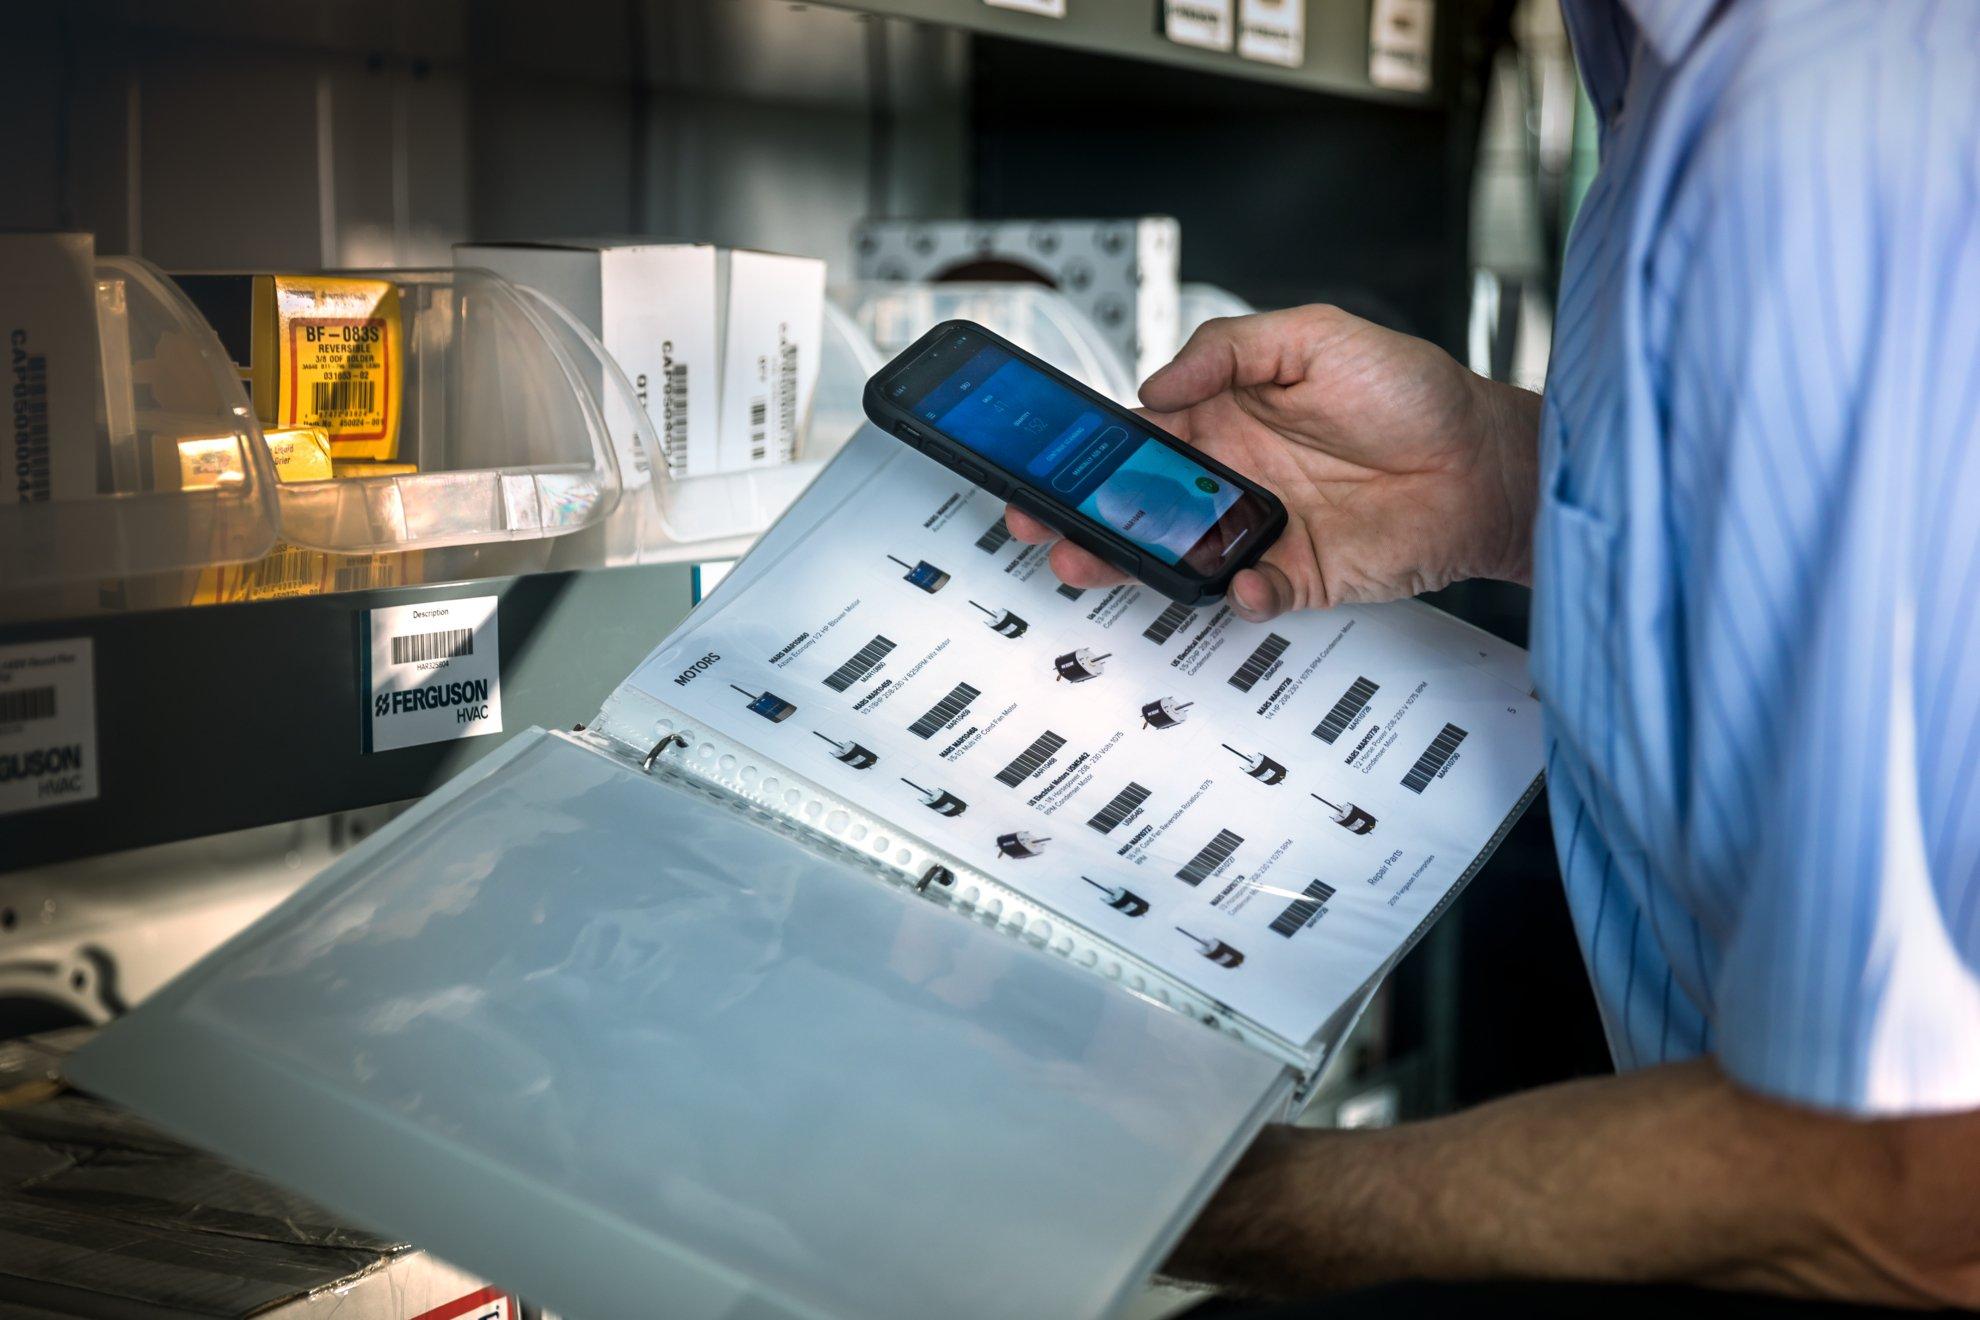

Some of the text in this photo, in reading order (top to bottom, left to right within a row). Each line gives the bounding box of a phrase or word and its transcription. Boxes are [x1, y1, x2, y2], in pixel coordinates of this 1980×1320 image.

[319, 344, 370, 353] REVERSIBLE
[413, 608, 449, 618] Description
[789, 637, 817, 658] Economy
[843, 598, 861, 612] Motor
[935, 637, 951, 652] Motor
[767, 650, 786, 664] MARS
[673, 651, 721, 687] MOTORS
[392, 679, 488, 714] FERGUSON
[852, 697, 869, 710] MARS
[1256, 700, 1272, 715] MARS
[457, 705, 488, 723] HVAC
[980, 722, 996, 735] Cond
[991, 714, 1005, 724] Fan
[1000, 701, 1018, 716] Motor
[1344, 724, 1381, 765] MARS MAR10730
[1371, 730, 1389, 747] Power
[938, 745, 955, 758] MARS
[1361, 731, 1400, 774] Condenser Motor
[1436, 751, 1461, 779] MAR10730
[38, 774, 81, 797] HVAC
[1032, 782, 1056, 801] Electrical
[1051, 770, 1070, 786] Motors
[1367, 848, 1403, 886] Repair Parts
